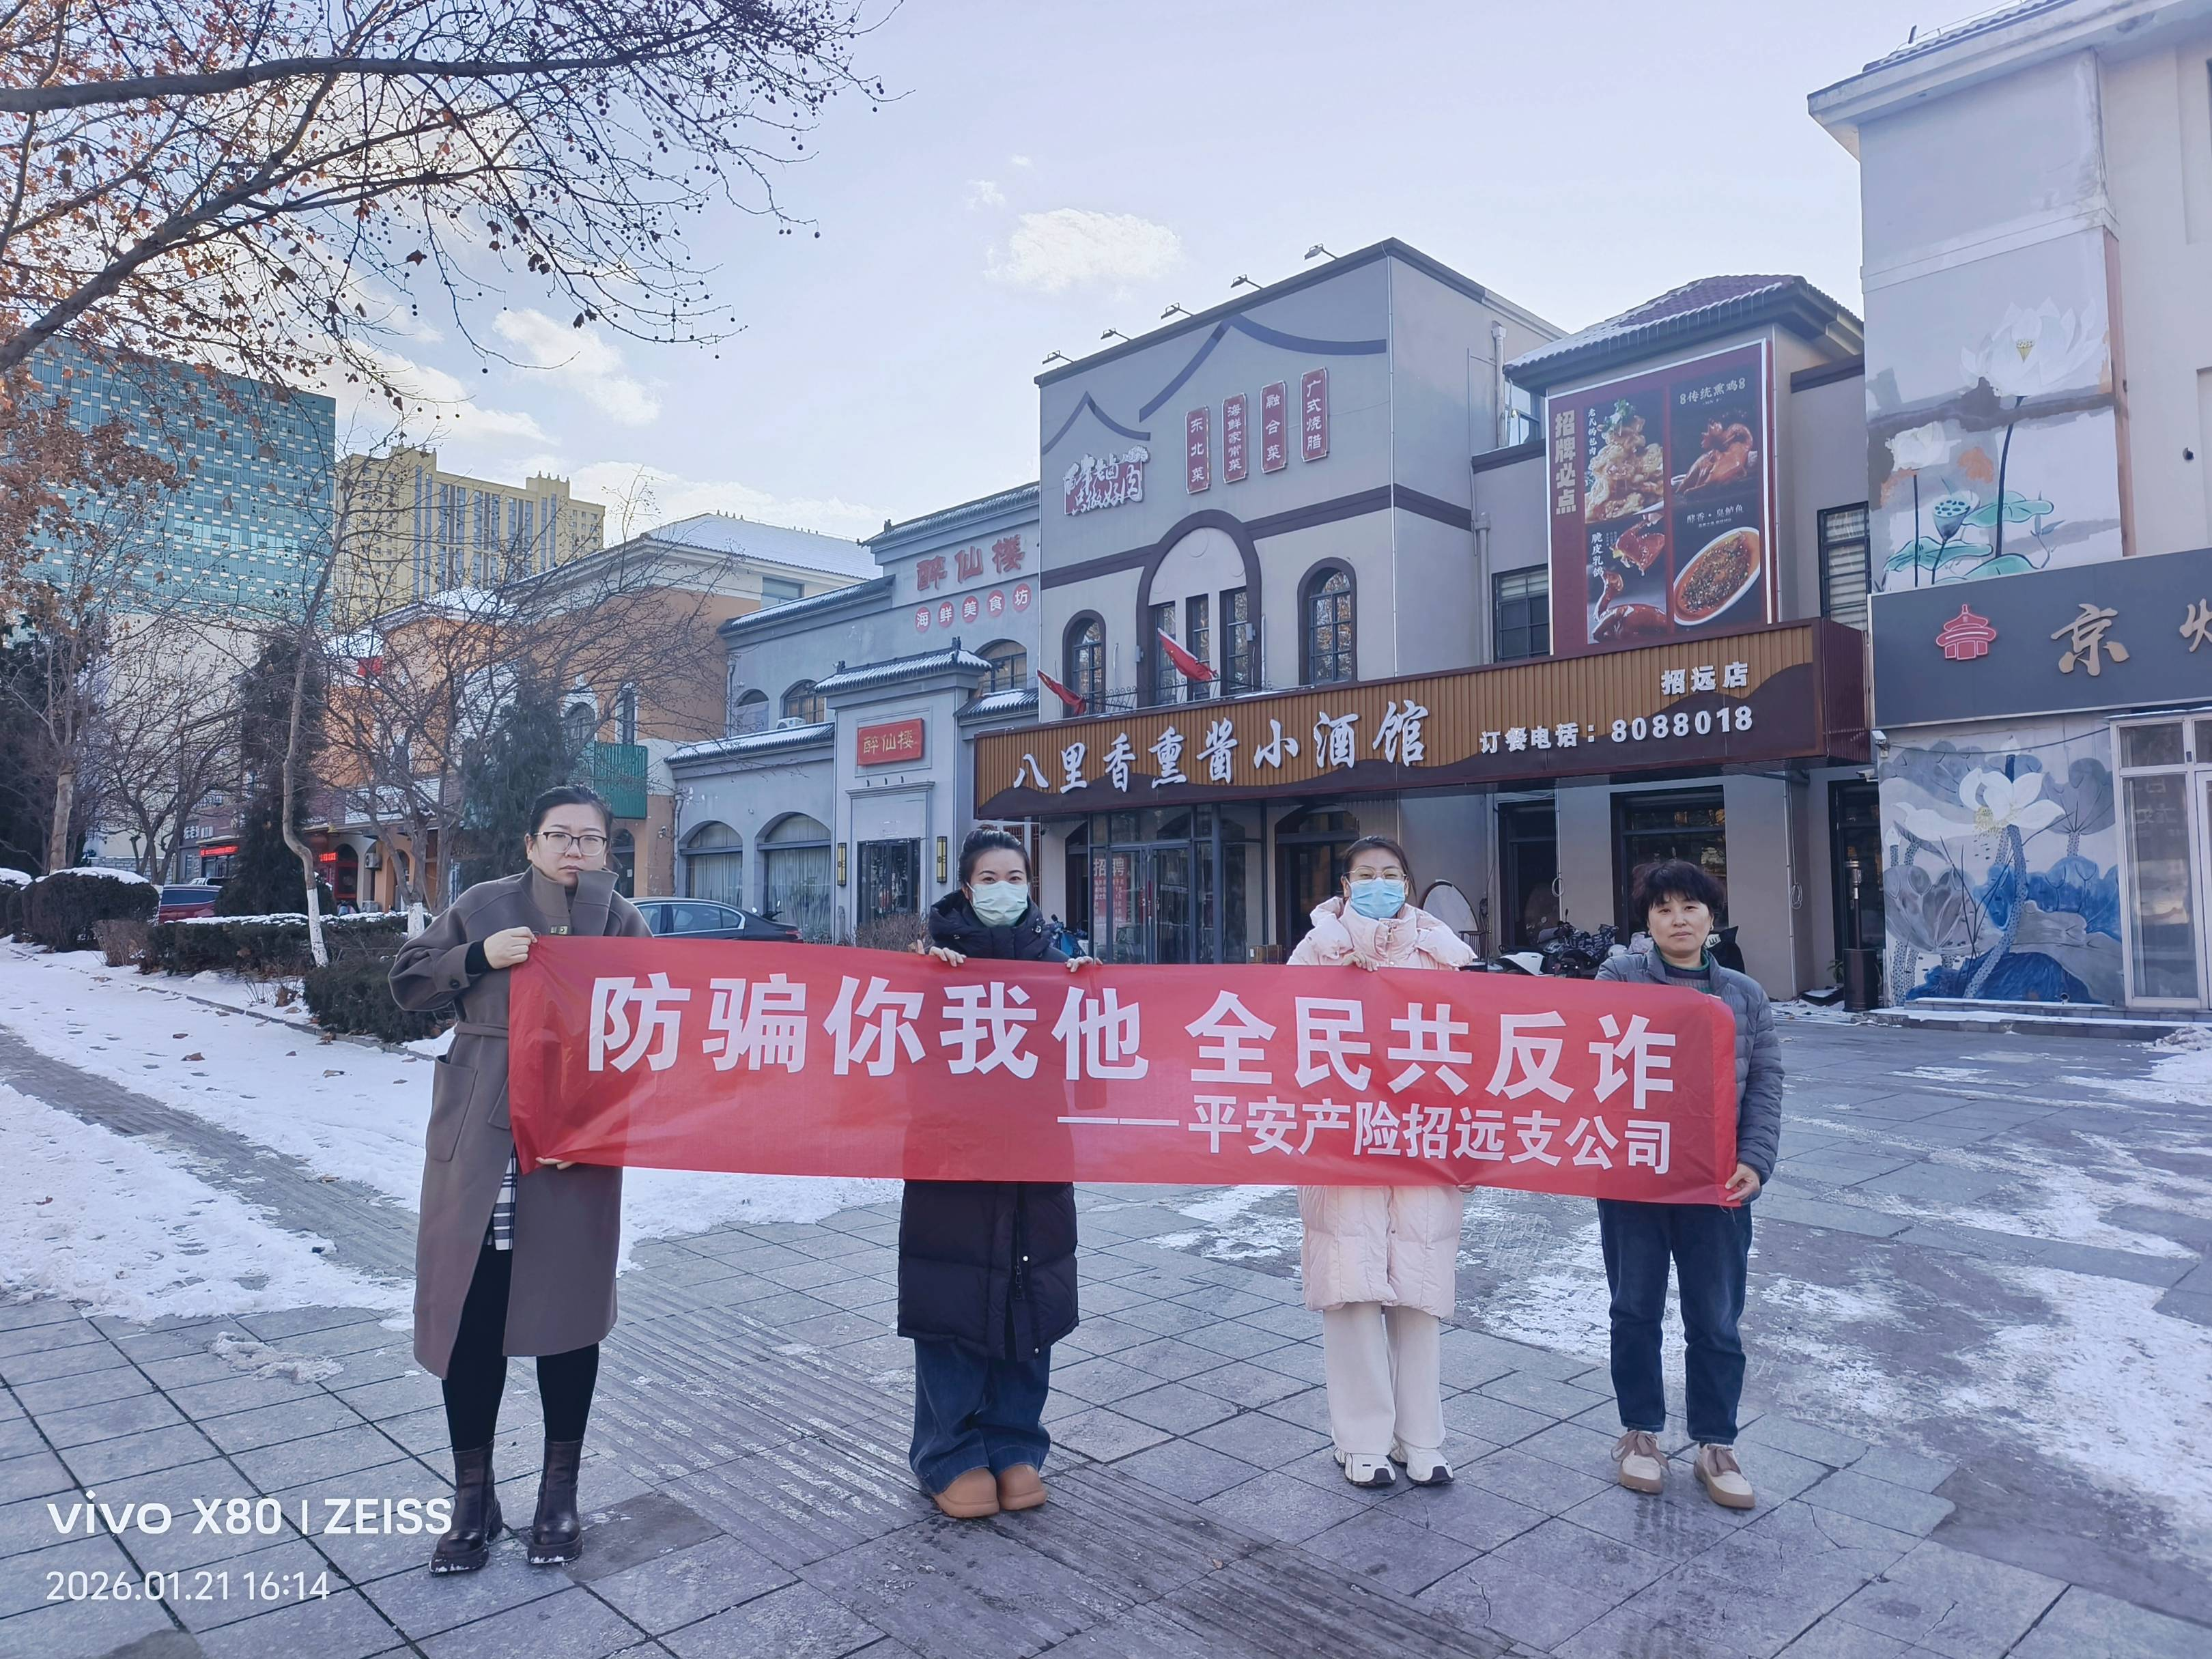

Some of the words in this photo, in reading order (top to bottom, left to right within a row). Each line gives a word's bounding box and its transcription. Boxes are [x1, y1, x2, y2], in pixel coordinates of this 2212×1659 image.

[1228, 405, 1242, 471] 海鲜家常菜
[1266, 394, 1281, 461] 融合菜
[1306, 380, 1322, 450] 广式烧腊
[1190, 417, 1205, 482] 东北菜
[1555, 410, 1576, 515] 招牌必点
[916, 534, 1025, 591] 醉仙楼
[1591, 532, 1604, 578] 脆皮乳鸽
[916, 590, 1029, 628] 海鲜美食坊
[1660, 661, 1748, 696] 招远店
[863, 729, 914, 754] 醉仙楼
[1094, 857, 1124, 877] 招聘
[587, 972, 1148, 1081] 防骗你我他
[1184, 989, 1677, 1110] 全民共反诈
